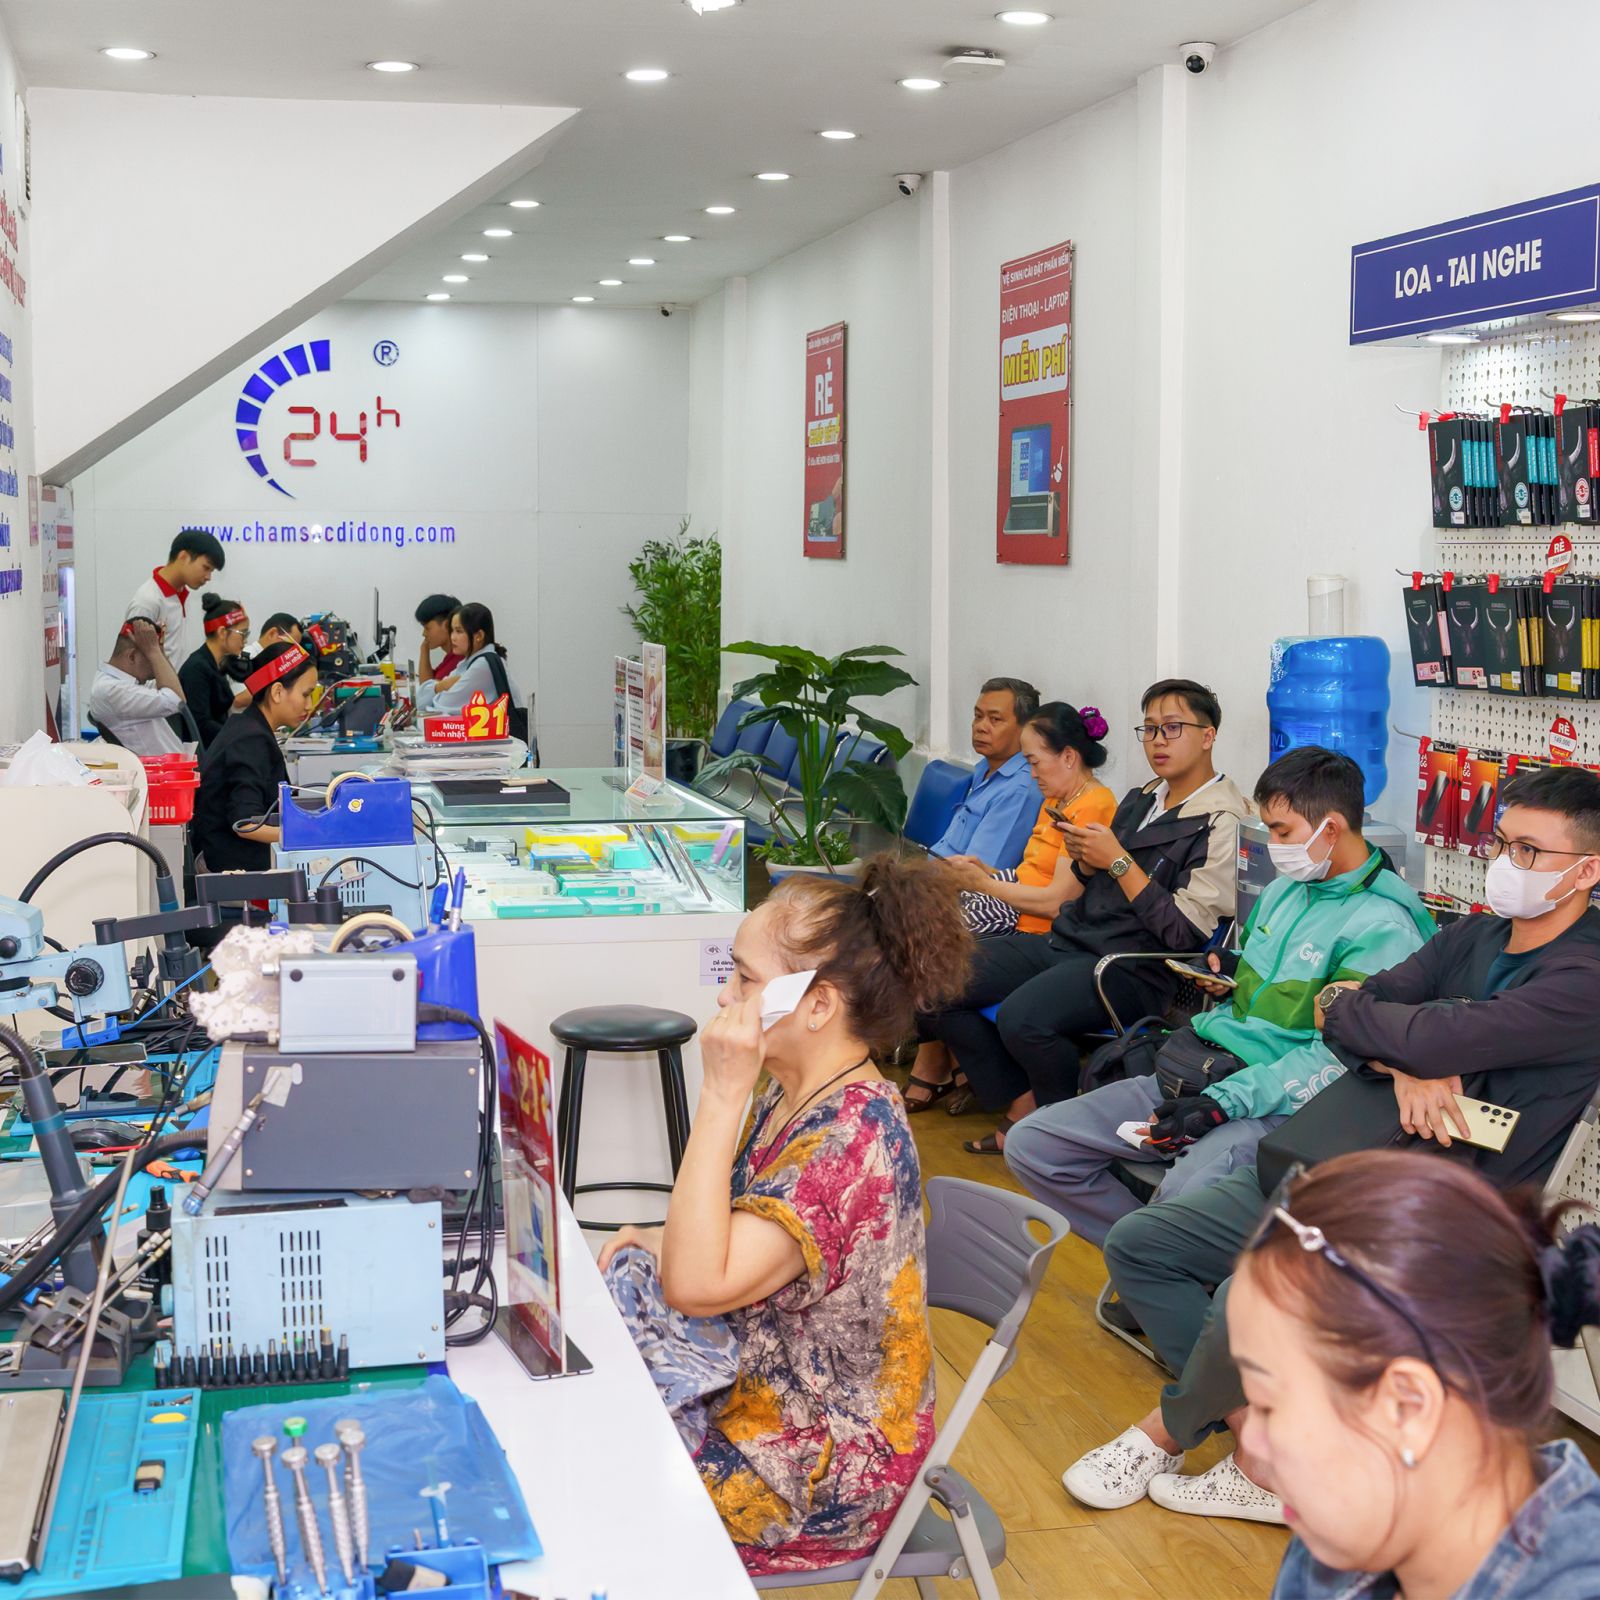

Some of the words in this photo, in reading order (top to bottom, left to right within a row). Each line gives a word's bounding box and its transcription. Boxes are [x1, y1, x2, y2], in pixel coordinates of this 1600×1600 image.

[1395, 264, 1431, 298] LOA
[1448, 253, 1476, 288] TAI
[1483, 239, 1542, 281] NGHE
[1002, 304, 1018, 325] ĐIỆN
[1020, 300, 1040, 319] THOẠI
[1044, 291, 1069, 312] LAPTOP
[1003, 338, 1040, 388] MIỄN
[1042, 333, 1068, 380] PHÍ
[181, 521, 456, 547] w.chamscdidong.com
[443, 722, 466, 731] Mừng
[468, 700, 507, 737] 21
[432, 729, 446, 738] sinh
[447, 731, 466, 740] nhật
[1463, 769, 1471, 777] GG
